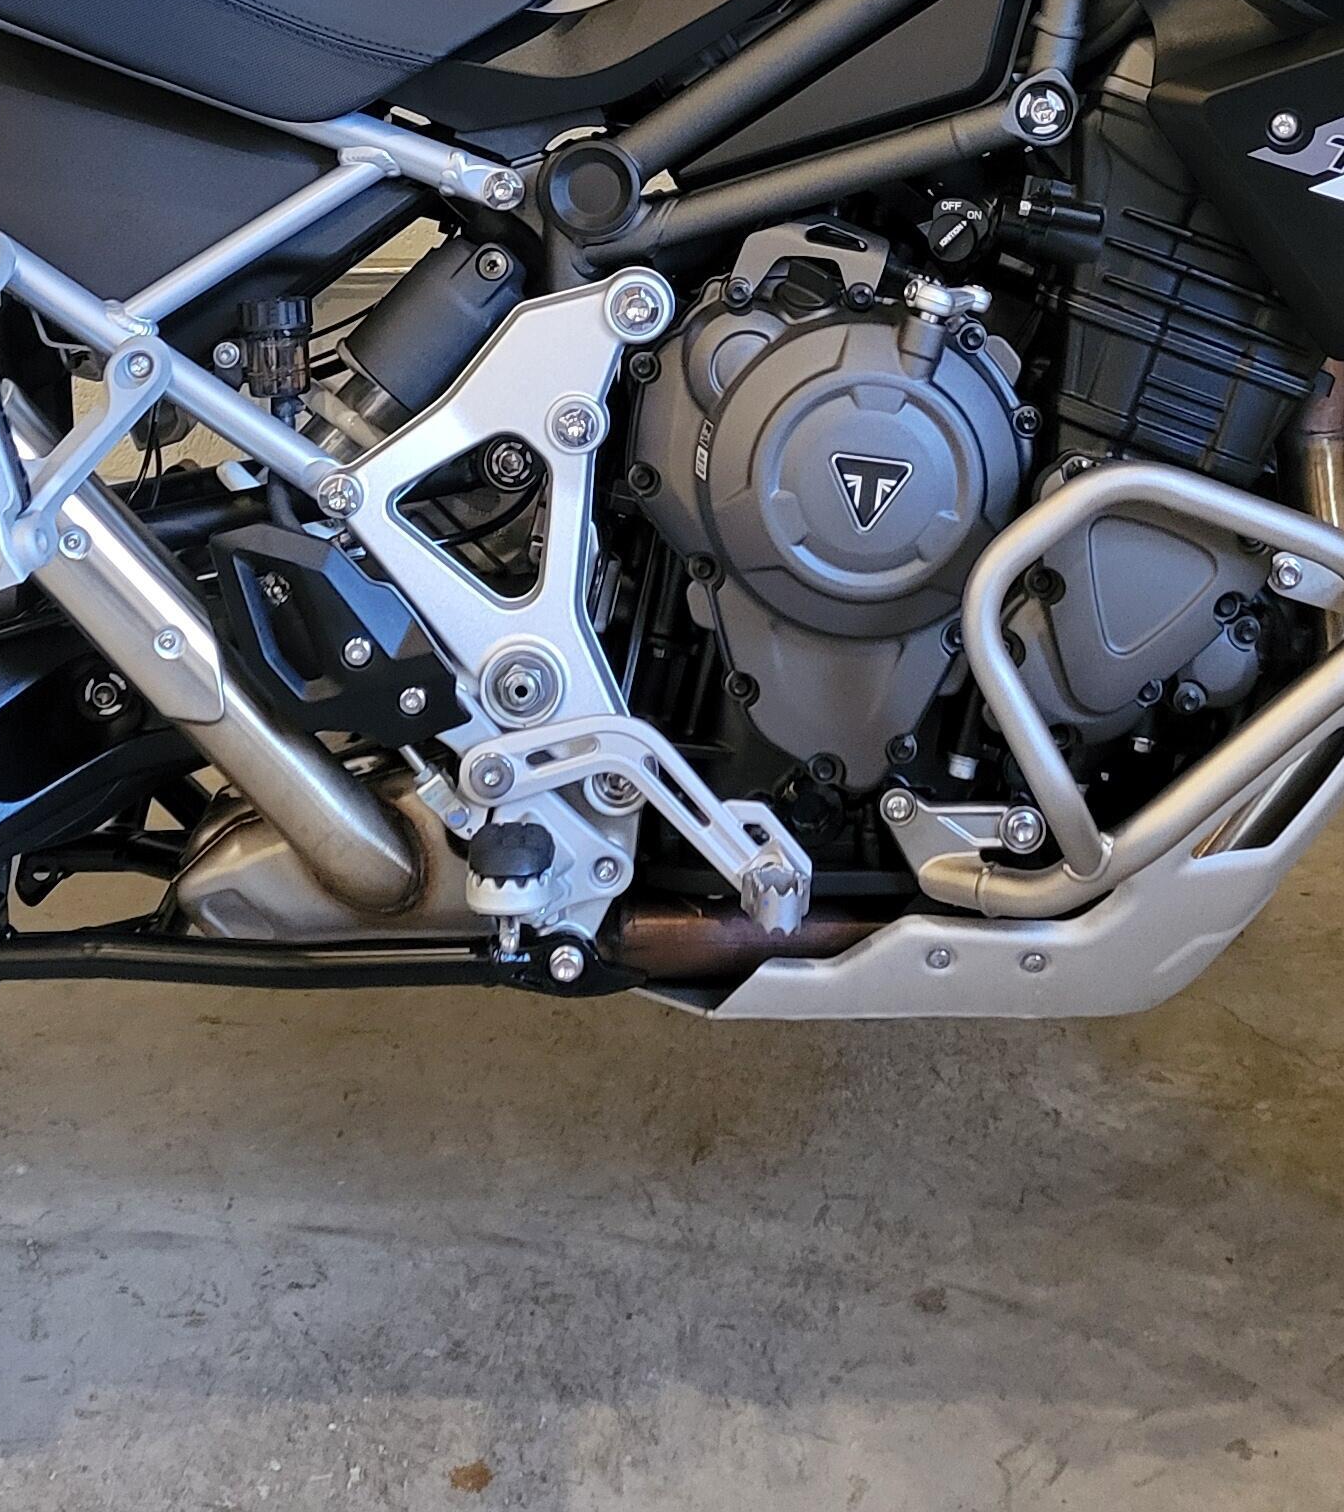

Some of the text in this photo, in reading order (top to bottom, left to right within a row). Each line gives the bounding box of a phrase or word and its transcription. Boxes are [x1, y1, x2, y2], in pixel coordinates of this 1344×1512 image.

[941, 201, 962, 211] OFF
[967, 210, 982, 220] ON
[939, 223, 964, 247] IGNITION
